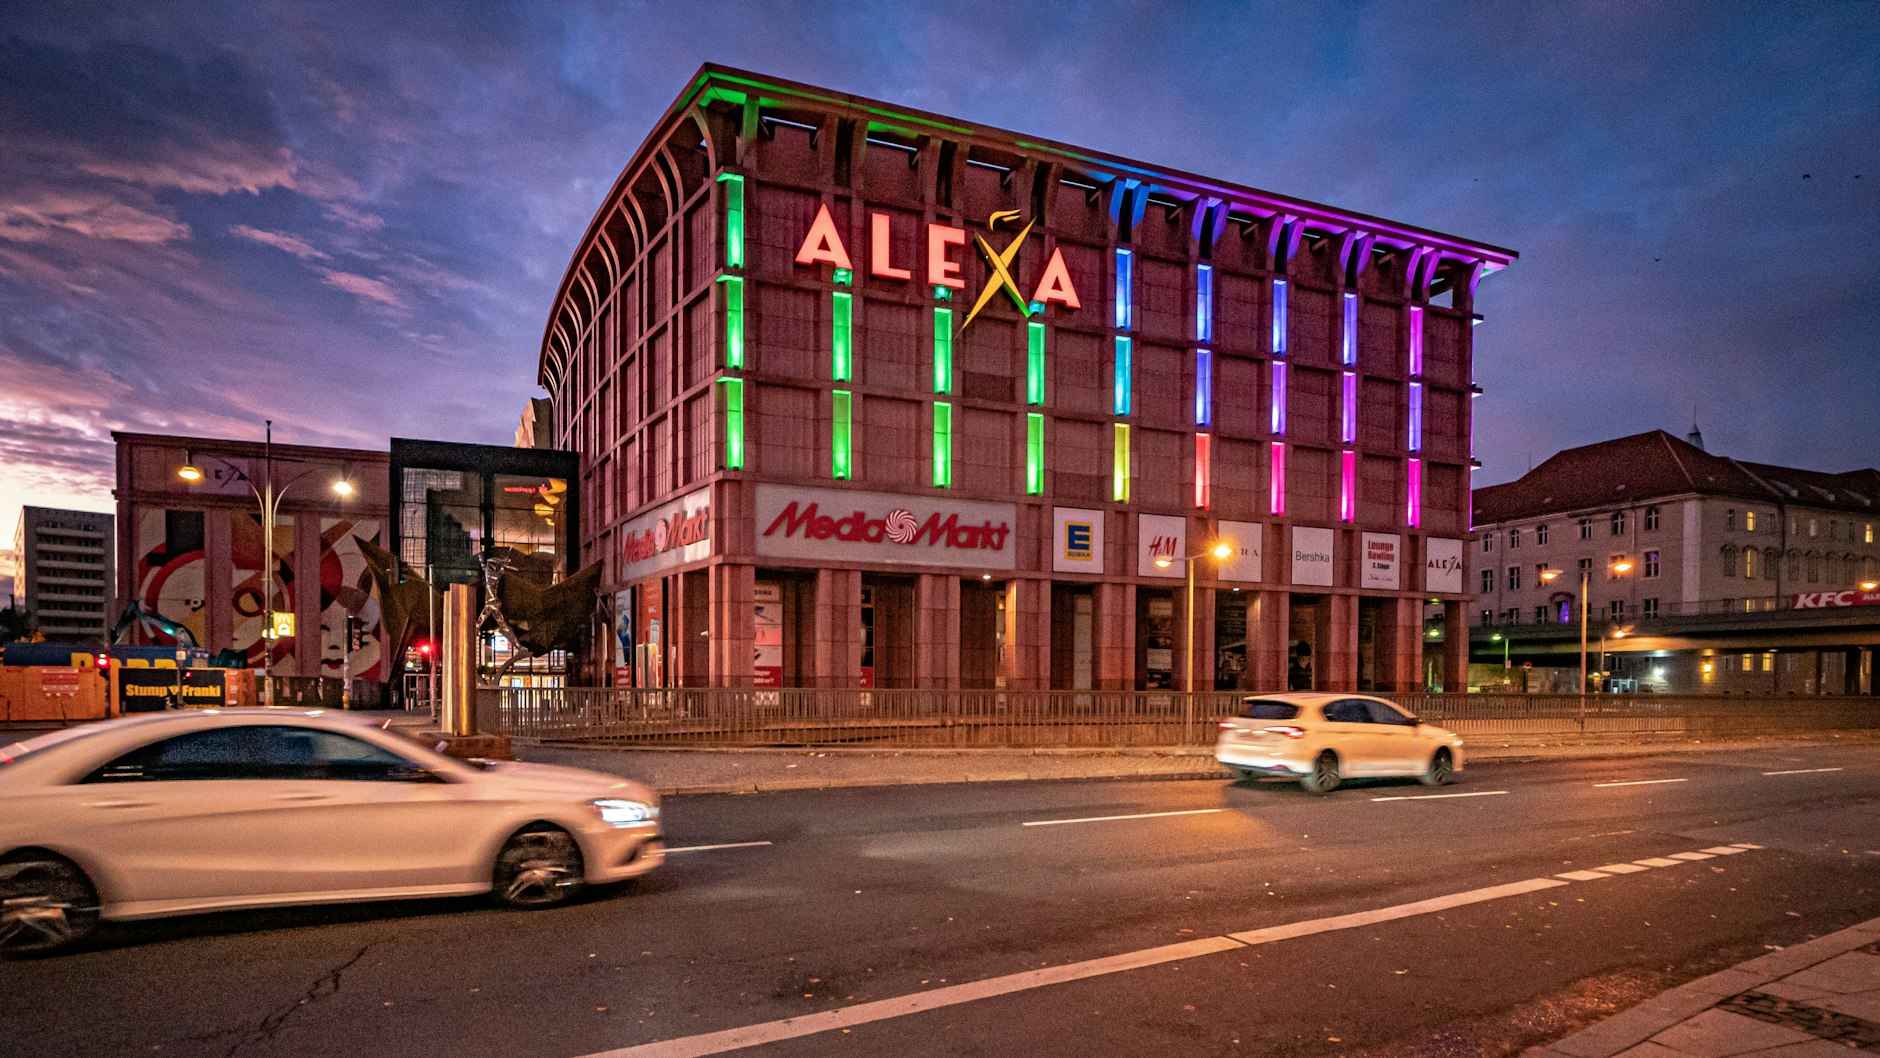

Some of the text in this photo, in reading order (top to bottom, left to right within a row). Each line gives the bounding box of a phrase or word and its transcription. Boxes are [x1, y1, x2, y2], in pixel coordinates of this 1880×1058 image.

[795, 203, 1081, 339] ALEXA
[763, 501, 1010, 551] Media Markt
[624, 508, 708, 563] Media Markt
[1148, 535, 1177, 556] H&M
[1368, 540, 1394, 551] Lounge
[1295, 551, 1330, 562] Bershka
[1368, 550, 1394, 561] Bowling
[1794, 591, 1855, 609] KFC
[126, 684, 167, 697] Stump
